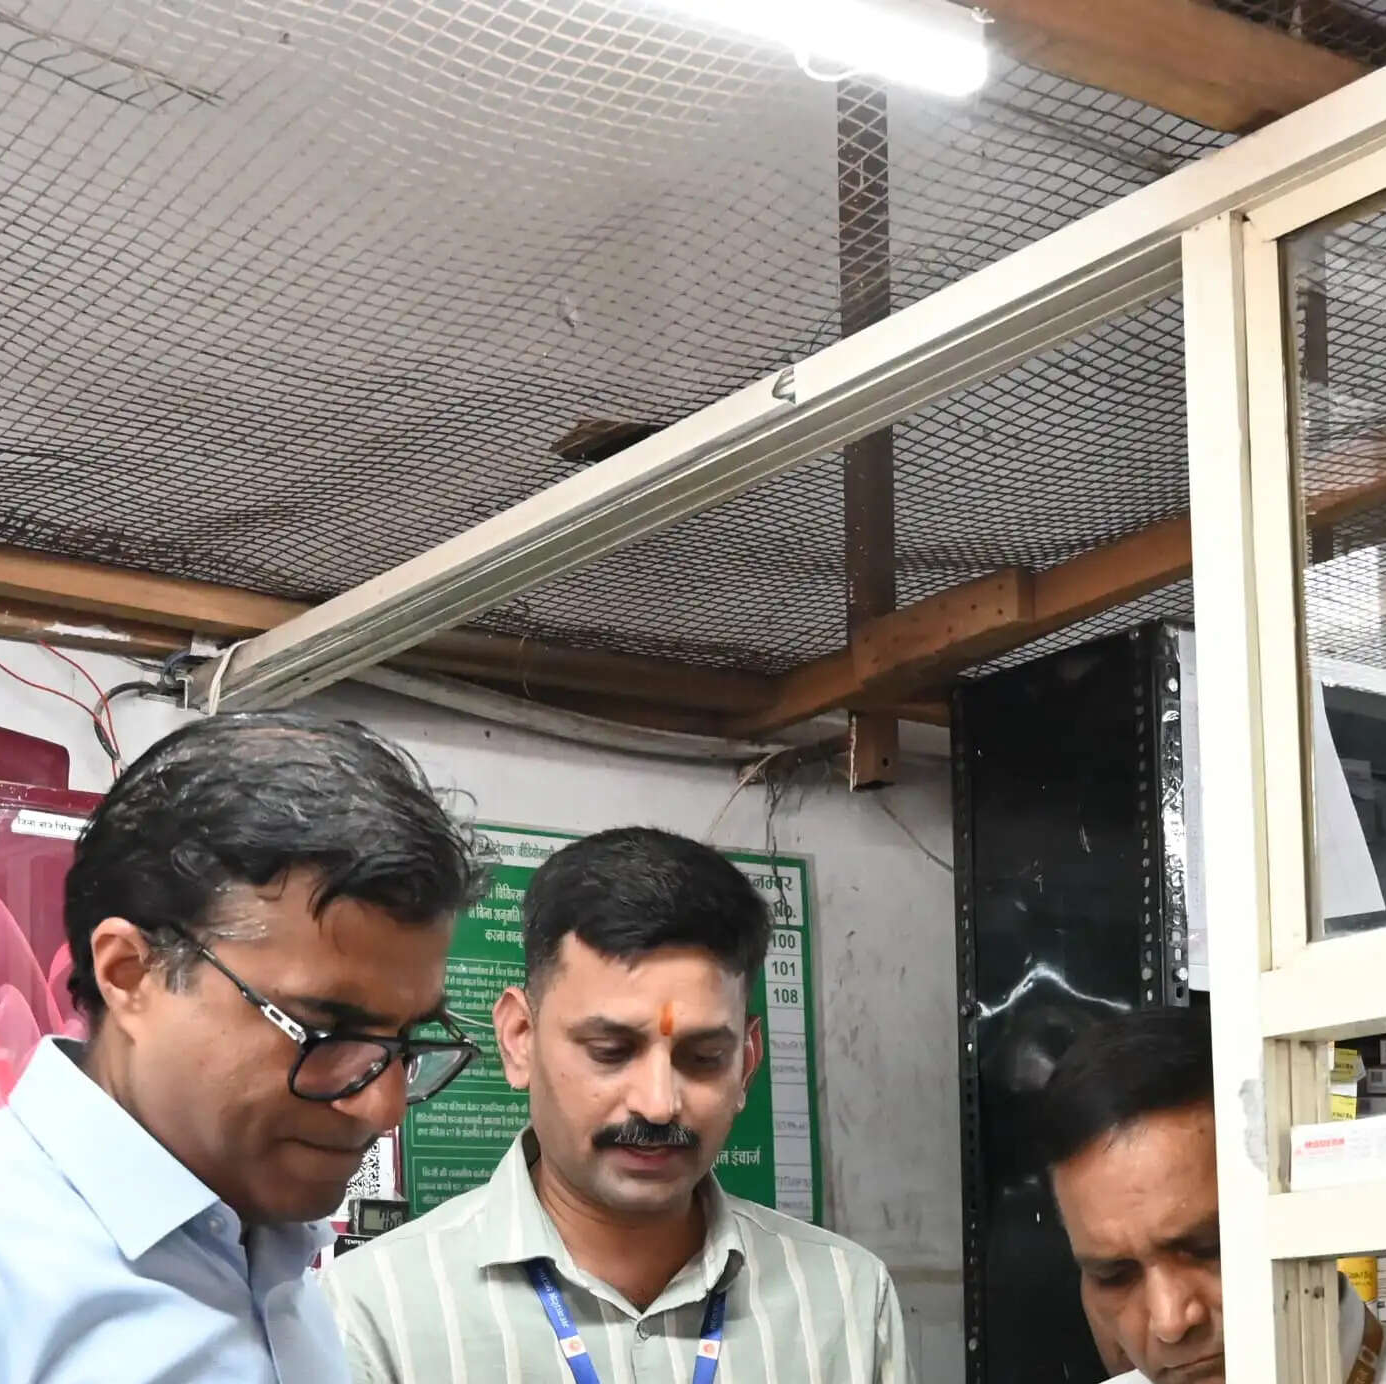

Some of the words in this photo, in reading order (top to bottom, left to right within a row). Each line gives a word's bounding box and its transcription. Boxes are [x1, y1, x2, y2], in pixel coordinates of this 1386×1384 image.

[771, 934, 796, 949] 100
[771, 961, 796, 976] 101
[773, 988, 798, 1003] 108
